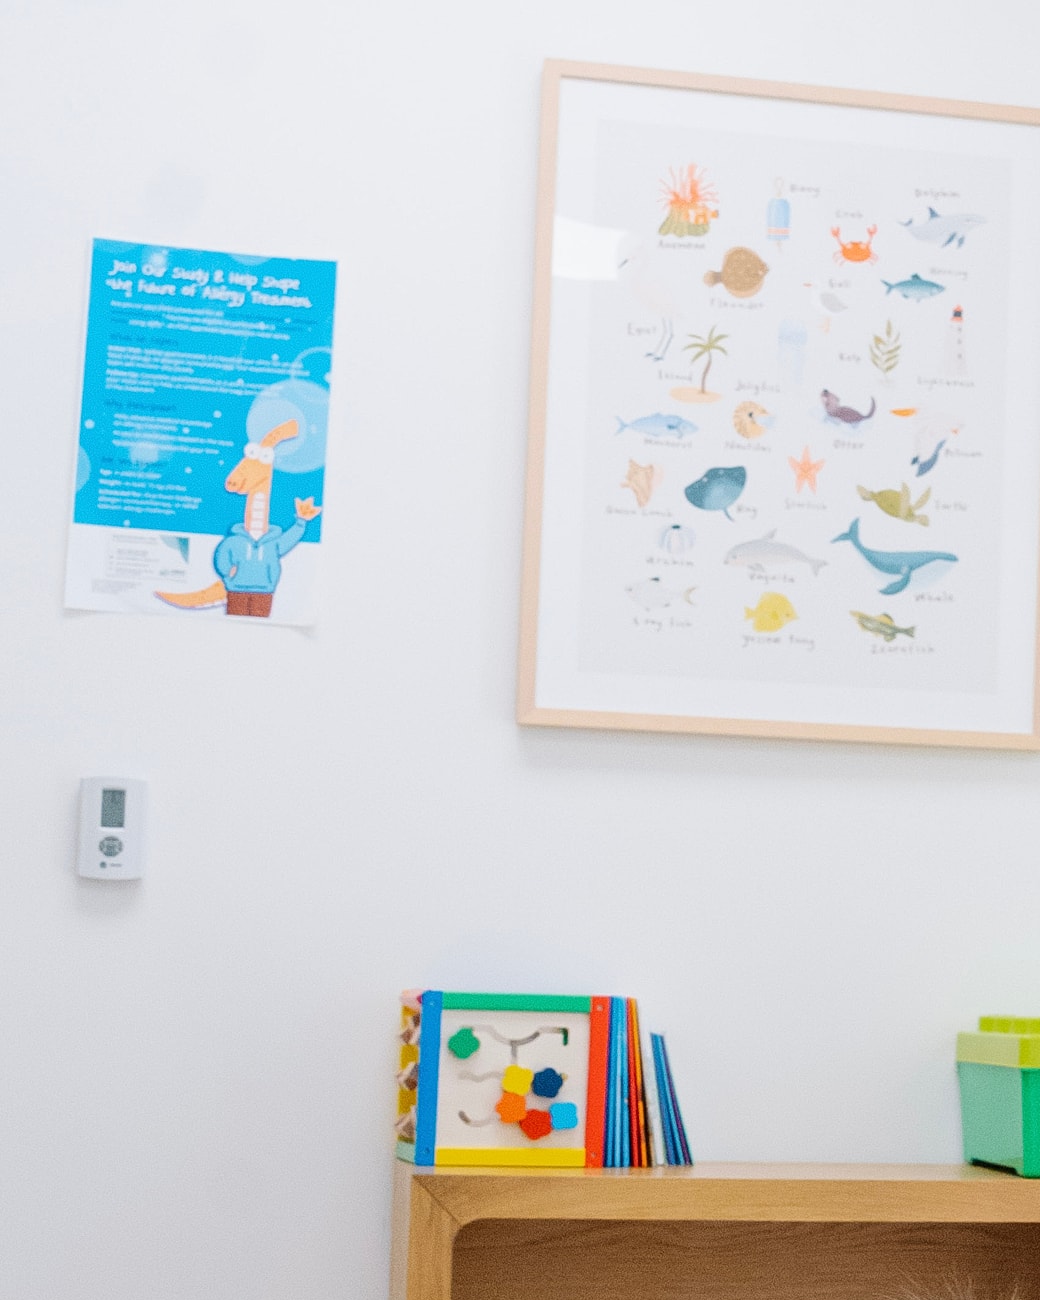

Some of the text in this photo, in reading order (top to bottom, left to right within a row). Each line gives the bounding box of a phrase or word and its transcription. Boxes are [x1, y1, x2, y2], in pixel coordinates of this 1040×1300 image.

[914, 187, 960, 199] Dolphin
[835, 209, 863, 219] Crab
[107, 259, 138, 277] Join
[141, 262, 168, 278] Our
[172, 267, 210, 287] Study
[228, 272, 259, 291] Help
[262, 276, 300, 294] Shape
[137, 279, 176, 296] Future
[180, 283, 197, 297] of
[201, 285, 246, 308] Allergy
[657, 369, 693, 382] Island
[833, 439, 864, 450] Otter
[914, 591, 955, 603] Whale
